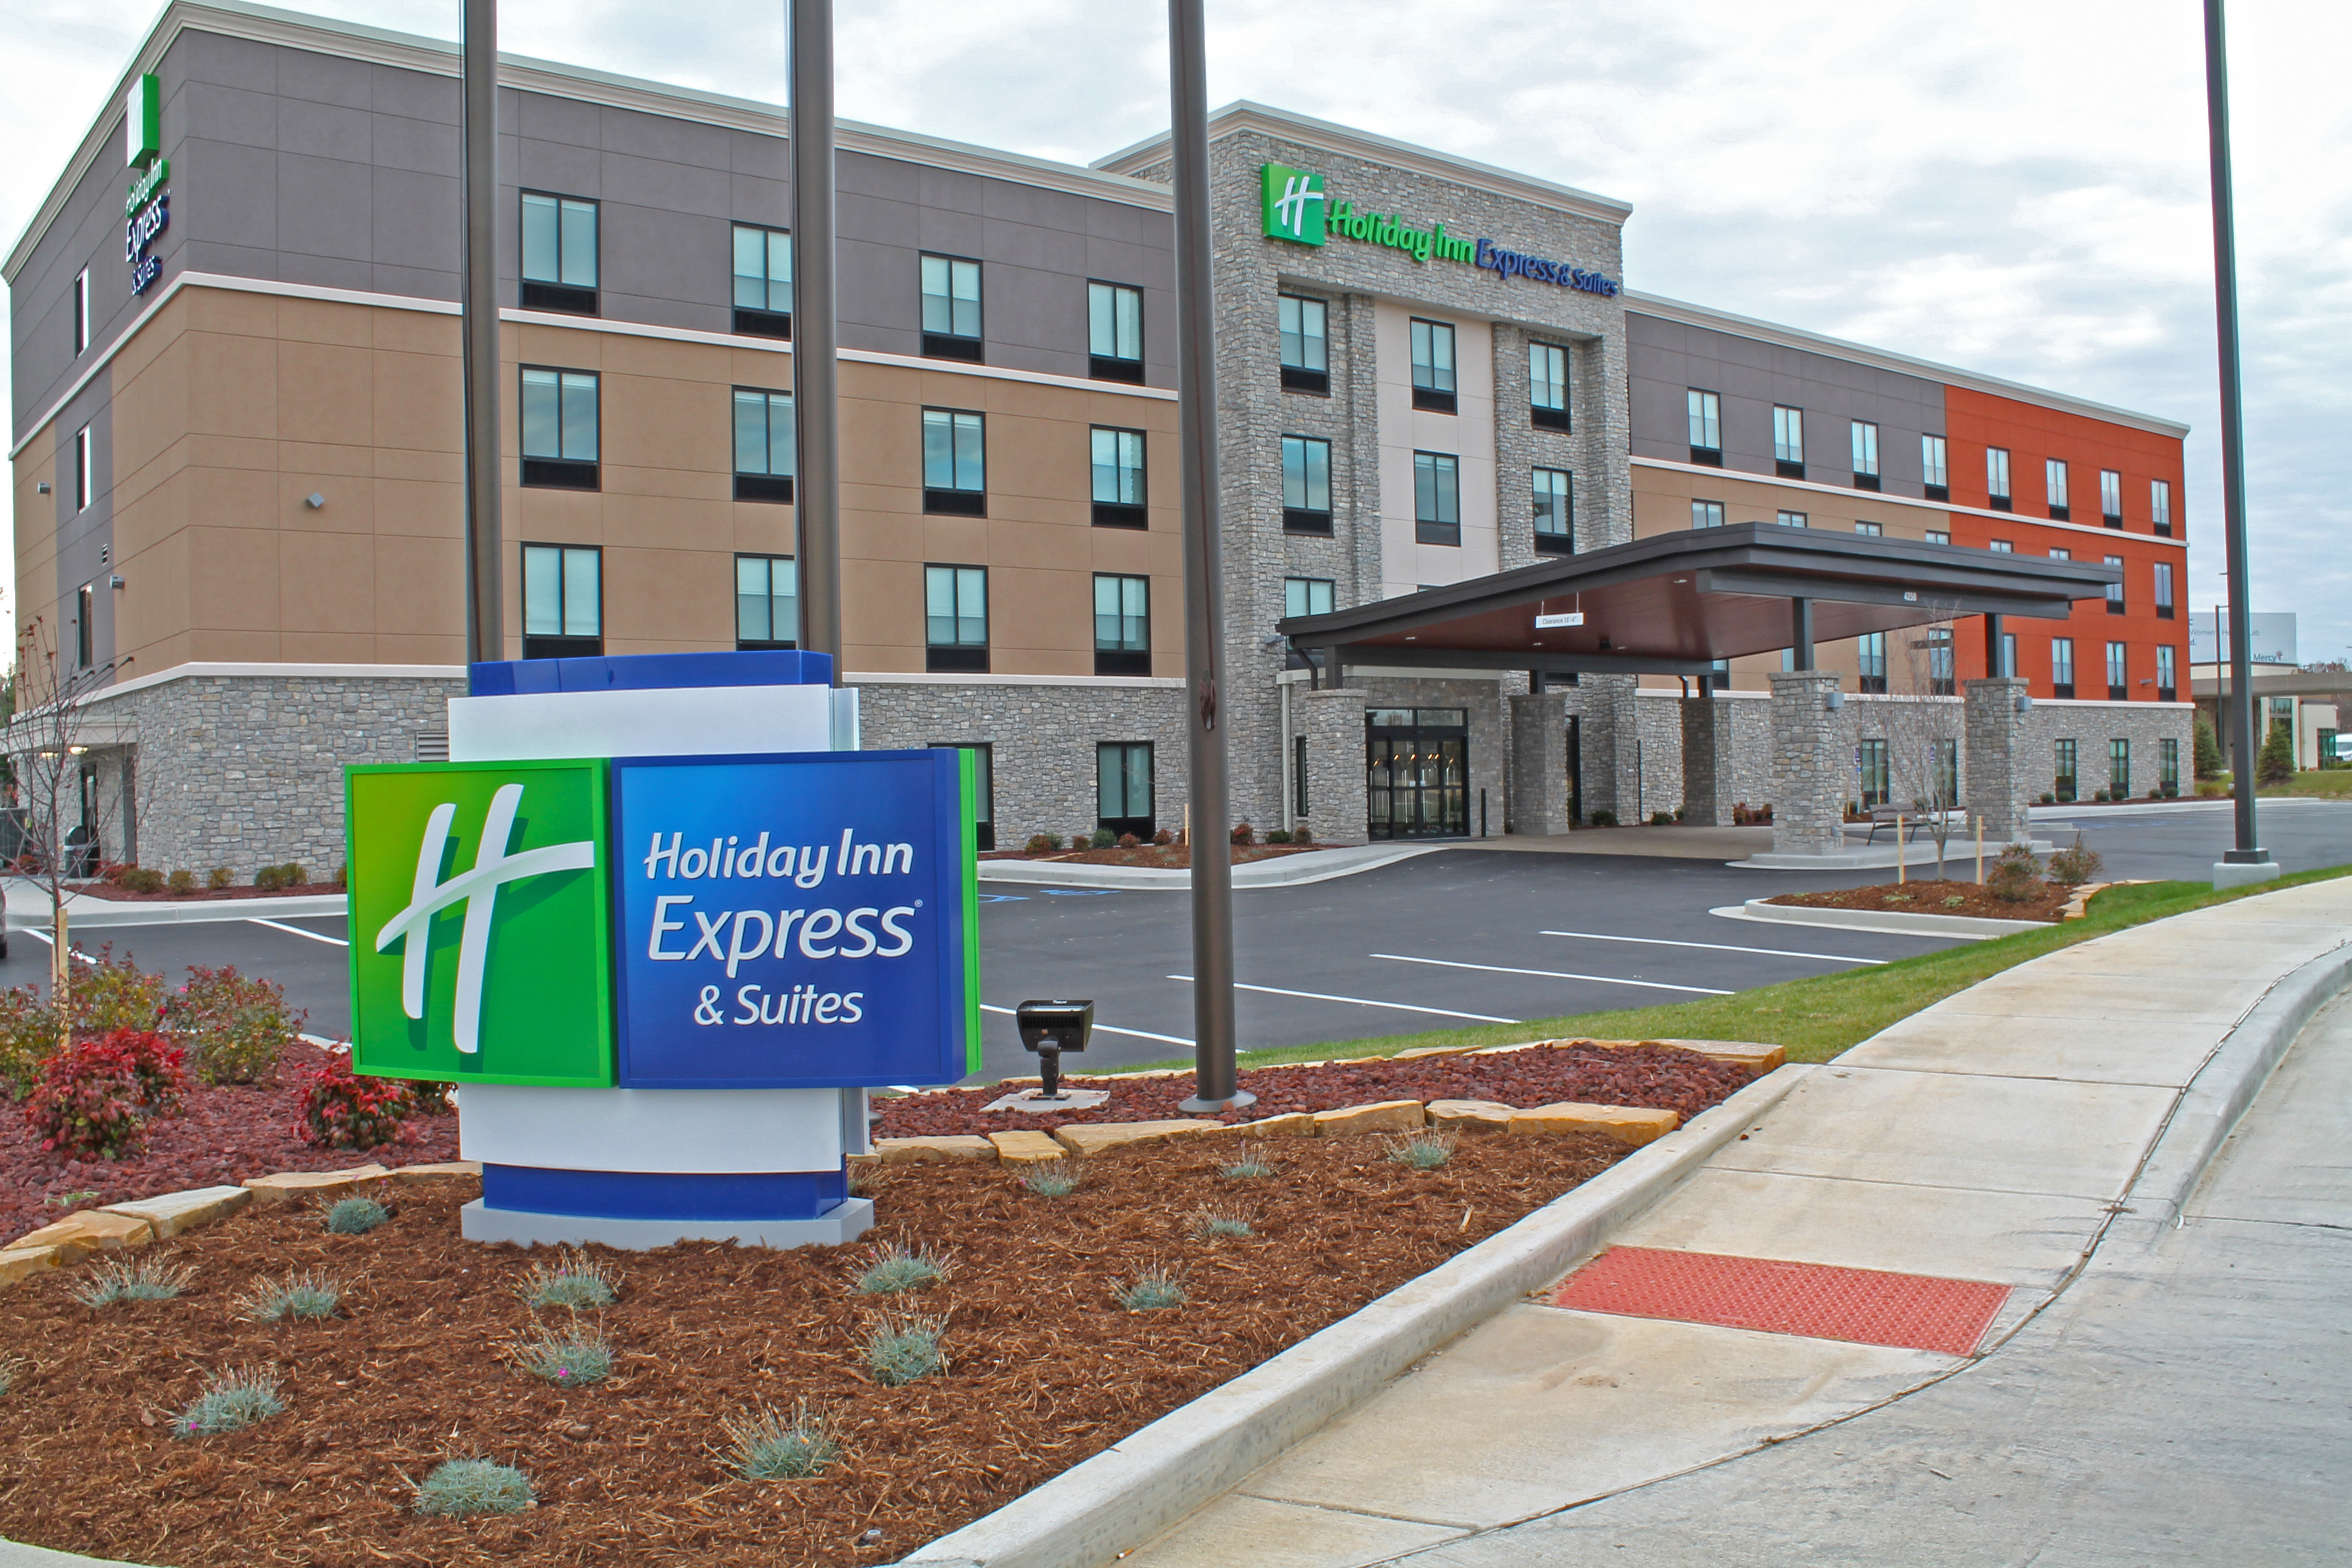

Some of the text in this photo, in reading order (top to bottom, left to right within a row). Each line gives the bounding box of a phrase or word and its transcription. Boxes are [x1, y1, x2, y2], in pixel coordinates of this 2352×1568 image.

[150, 158, 162, 189] Inn
[126, 194, 162, 263] Express
[1326, 199, 1619, 297] Holiday Inn Express & Suites
[2253, 653, 2277, 663] Mercy
[643, 827, 914, 889] Holiday Inn
[693, 984, 864, 1026] & Suites
